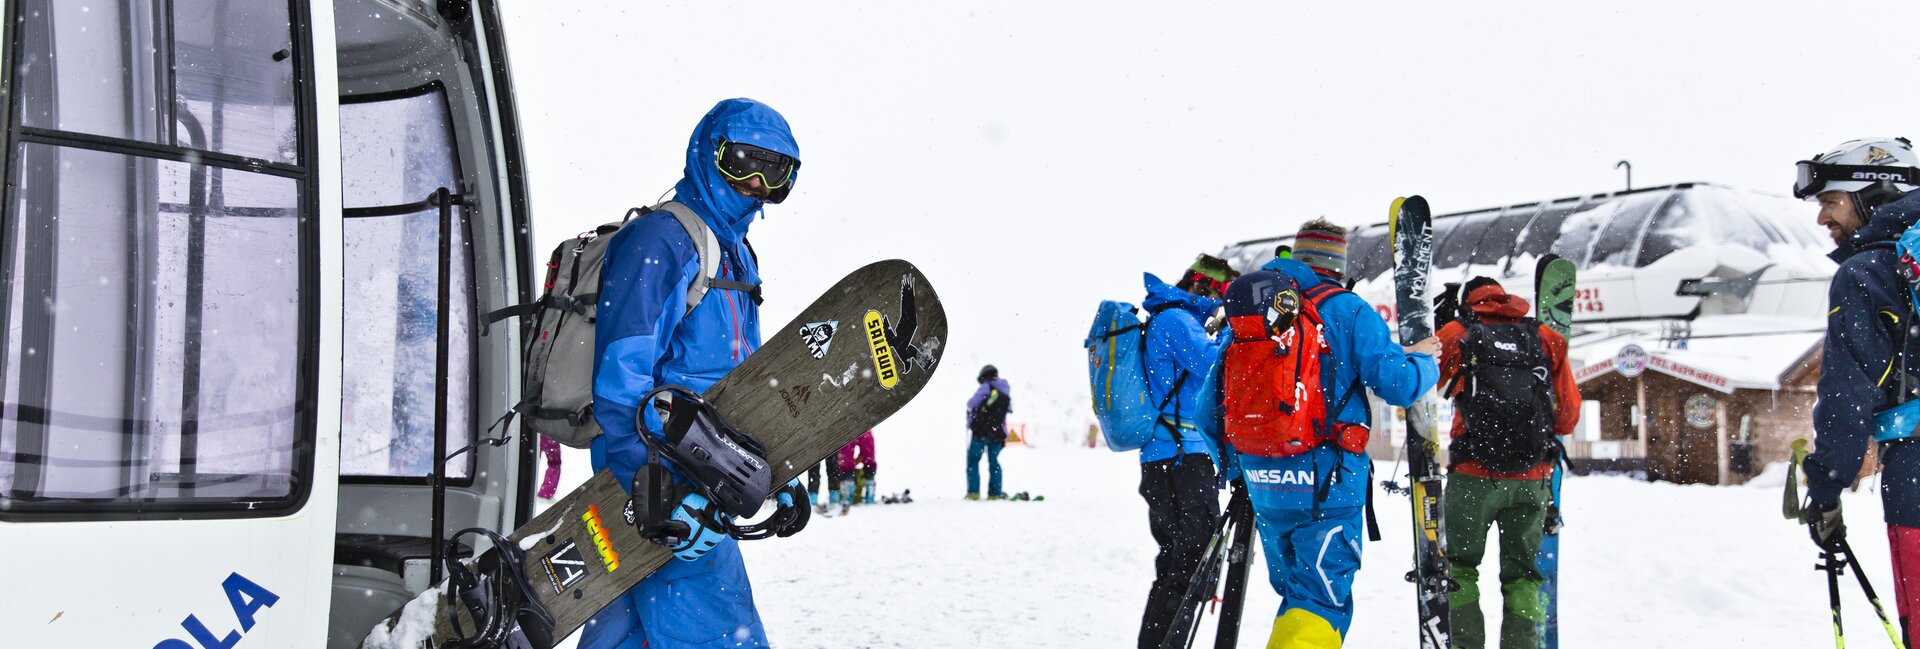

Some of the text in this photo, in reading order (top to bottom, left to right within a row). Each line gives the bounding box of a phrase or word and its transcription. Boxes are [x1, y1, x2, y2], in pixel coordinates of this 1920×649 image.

[1409, 220, 1433, 300] MOVEMENT
[799, 326, 824, 359] CAMP
[867, 319, 894, 380] SALEWA
[1245, 468, 1315, 486] NISSAN
[151, 571, 281, 649] LA
